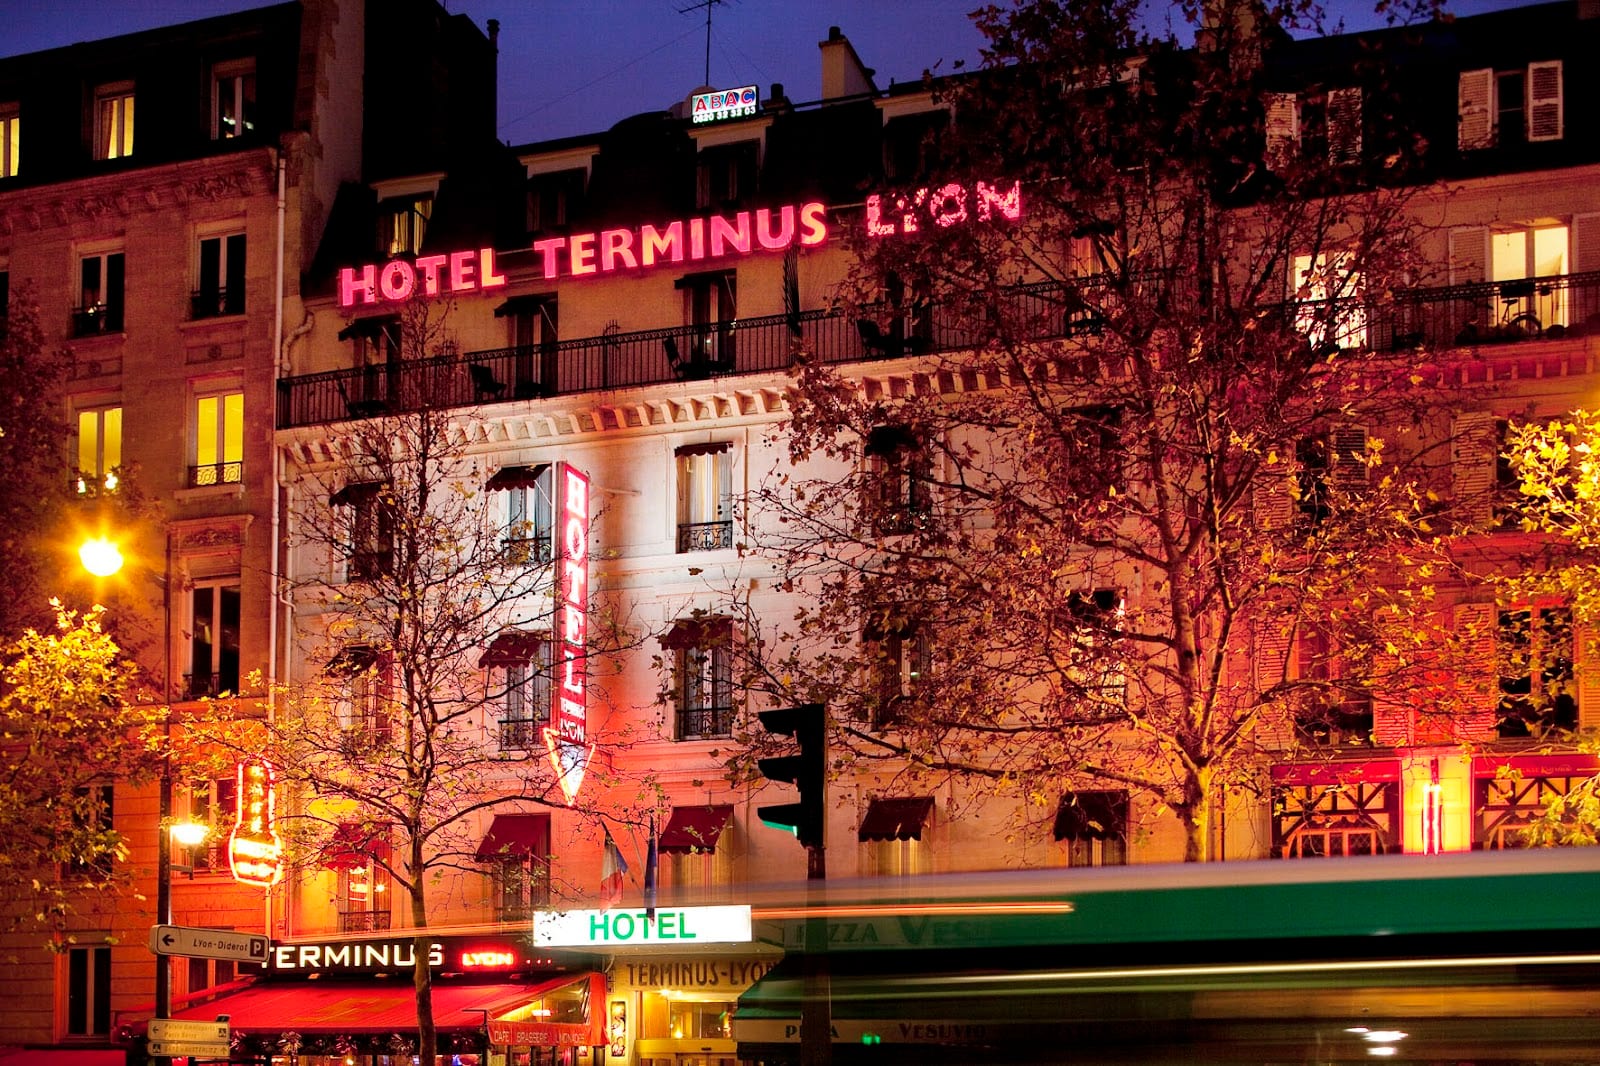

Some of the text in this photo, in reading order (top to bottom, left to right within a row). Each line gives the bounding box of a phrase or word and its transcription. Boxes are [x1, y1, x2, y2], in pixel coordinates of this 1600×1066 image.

[695, 88, 754, 112] ABAC
[744, 106, 756, 116] 03
[340, 179, 1021, 308] HOTEL TERMINUS LYON
[563, 471, 588, 694] HOTEL
[560, 718, 584, 742] LYON
[589, 911, 697, 941] HOTEL
[253, 941, 262, 954] P
[461, 951, 514, 967] LYON
